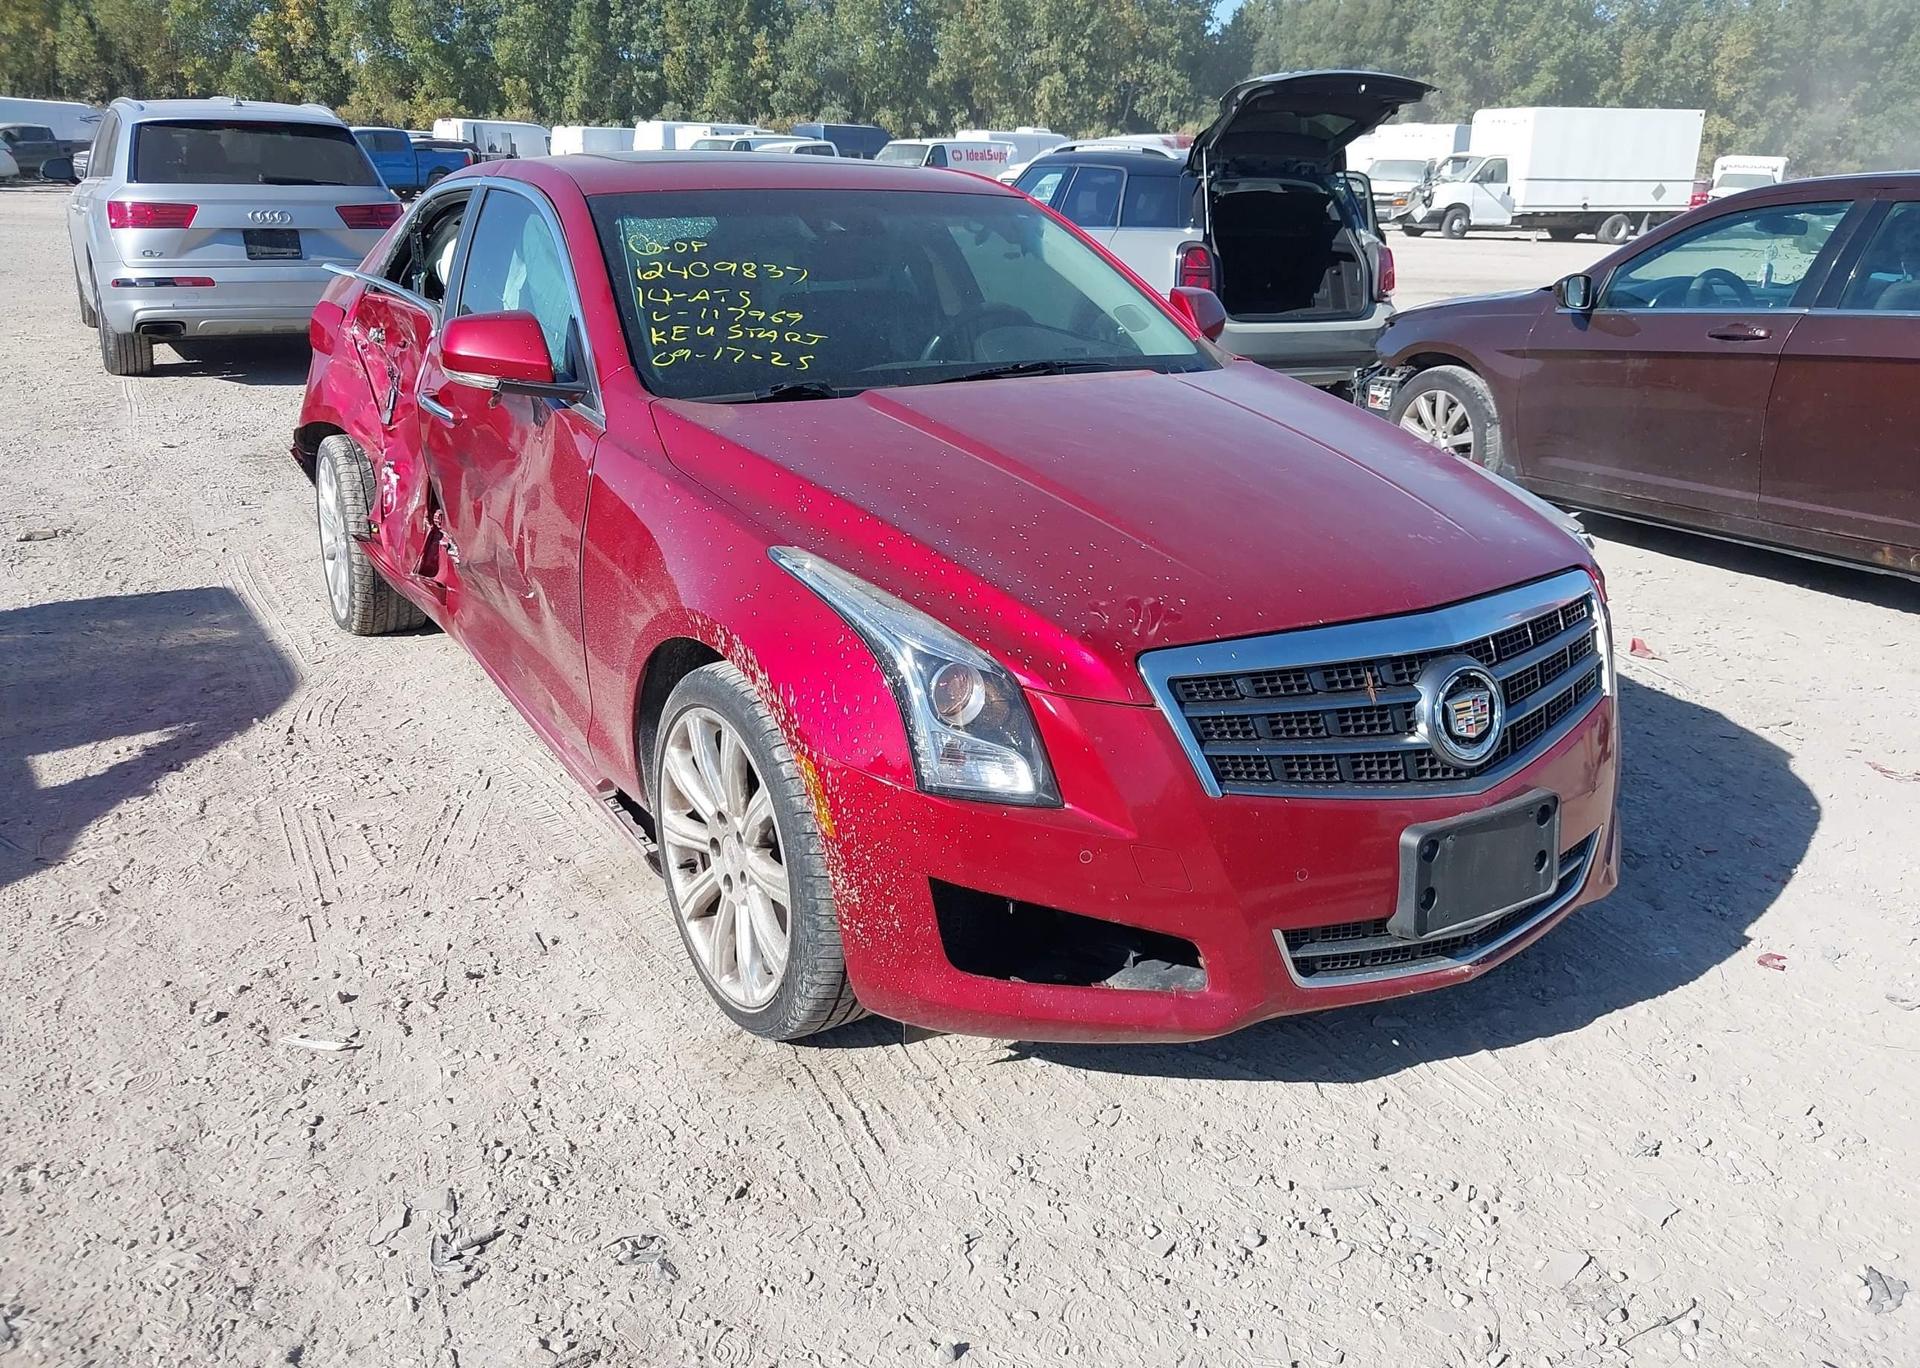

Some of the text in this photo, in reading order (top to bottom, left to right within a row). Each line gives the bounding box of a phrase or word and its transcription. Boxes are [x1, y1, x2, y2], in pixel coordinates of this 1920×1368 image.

[636, 259, 807, 285] 12409837
[727, 324, 829, 346] START
[652, 346, 815, 370] 09-17-25
